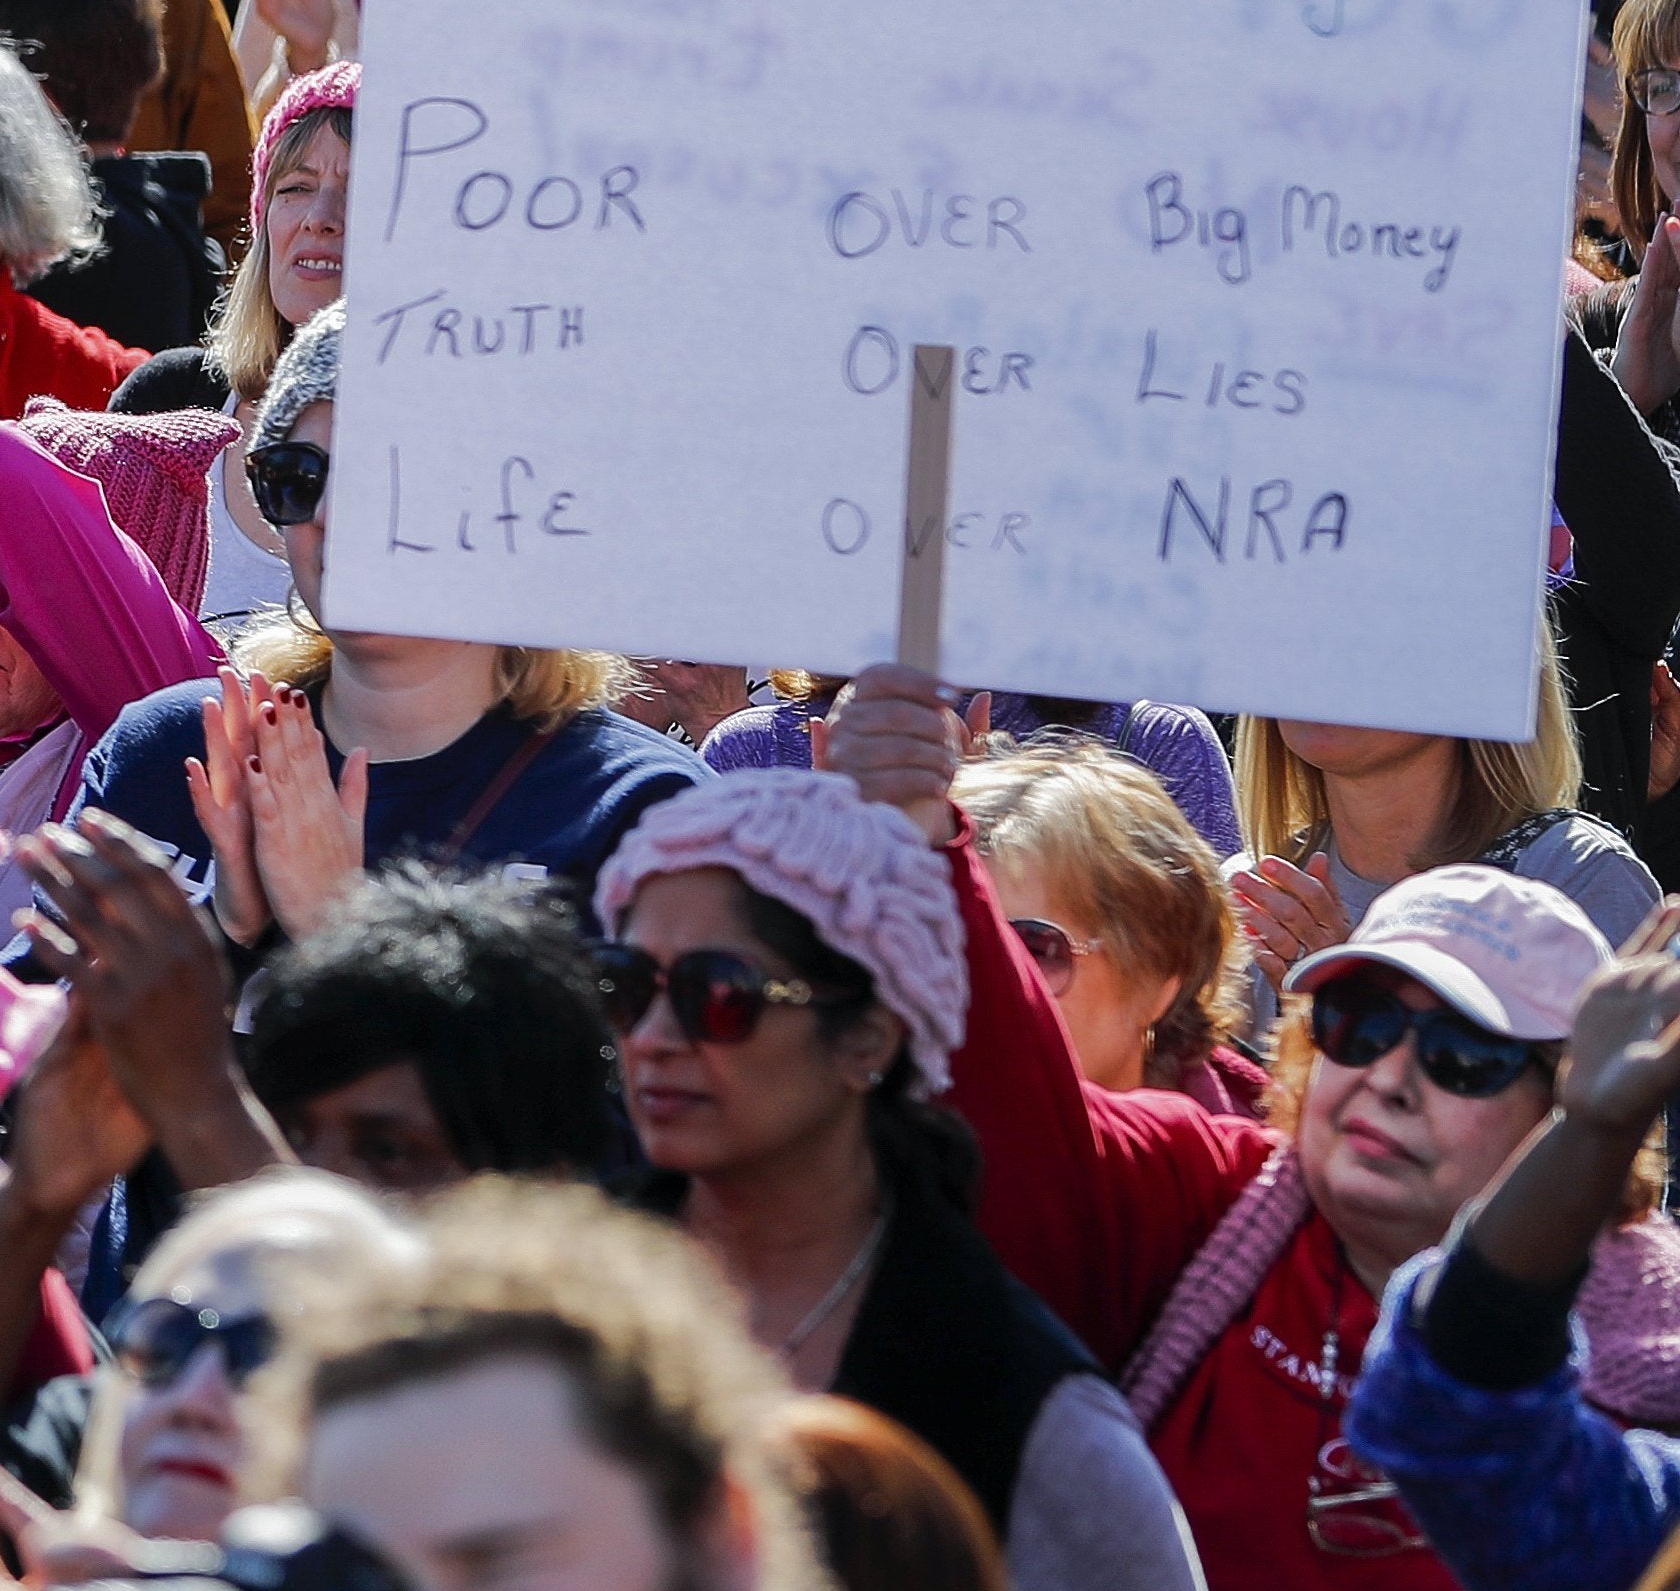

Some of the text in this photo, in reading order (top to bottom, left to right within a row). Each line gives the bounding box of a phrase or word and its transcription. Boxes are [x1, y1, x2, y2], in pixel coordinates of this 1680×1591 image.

[823, 187, 1037, 262] OVER
[1141, 167, 1252, 286] Big
[1281, 182, 1465, 294] Money
[370, 288, 587, 372] TRUTH
[385, 442, 591, 556] Life
[1157, 473, 1353, 565] NRA
